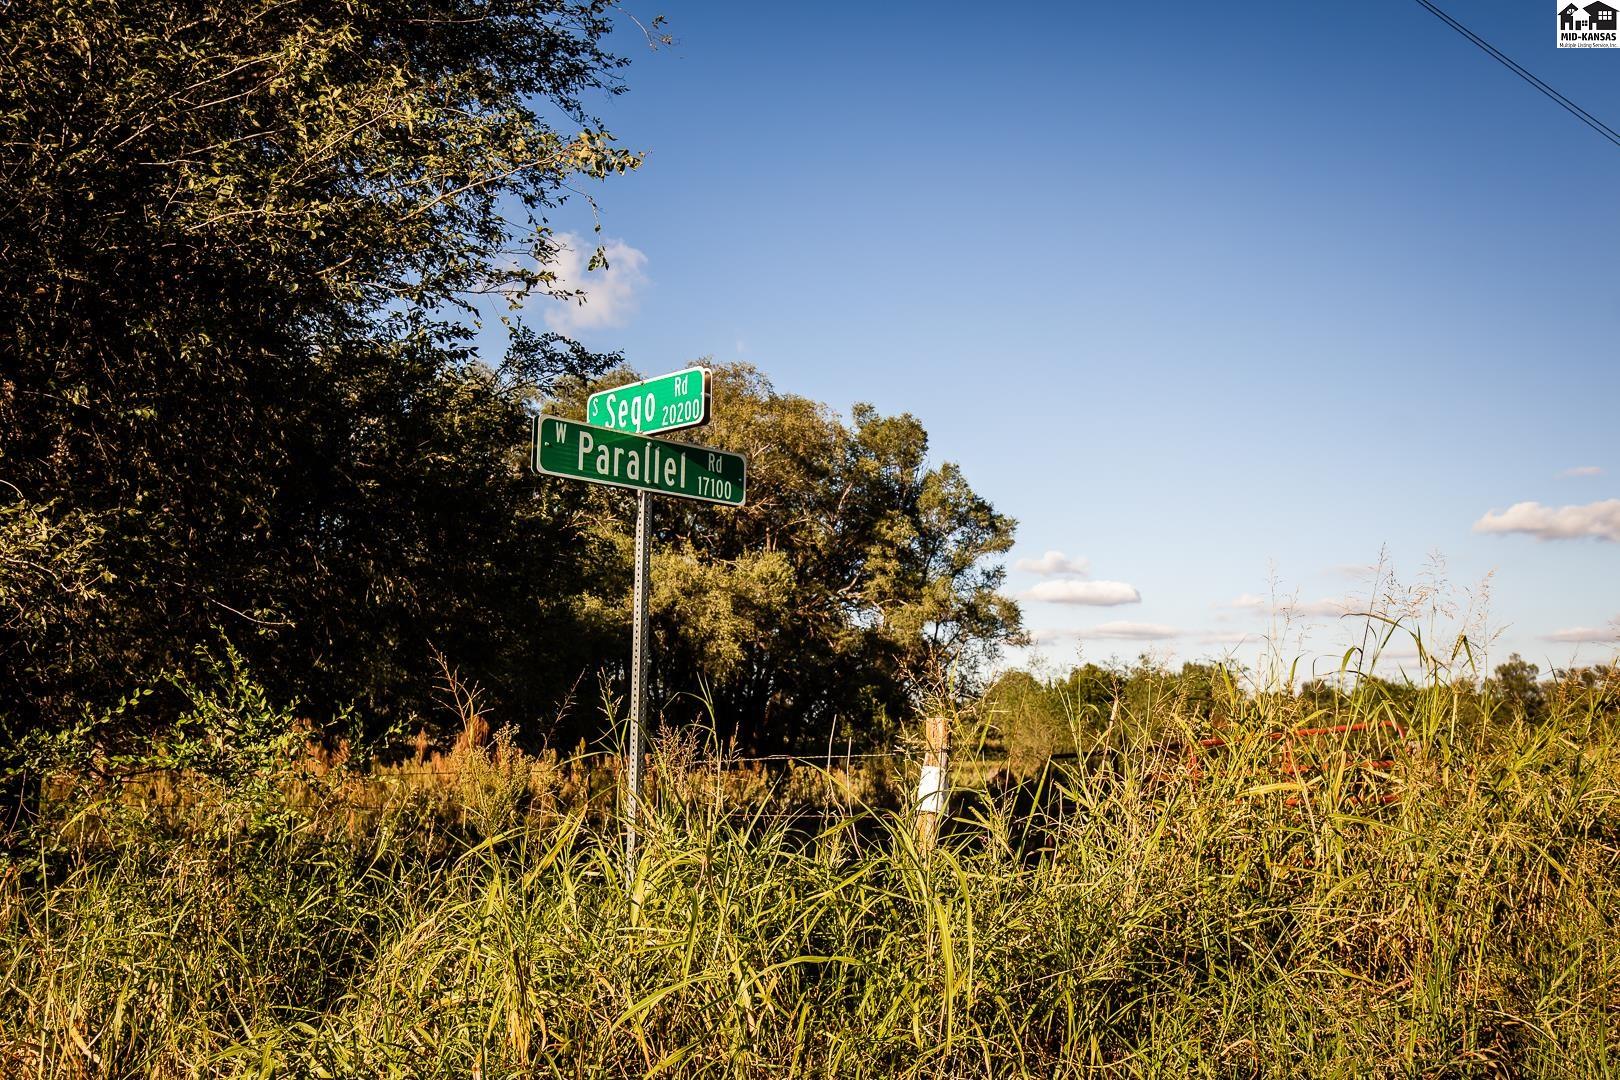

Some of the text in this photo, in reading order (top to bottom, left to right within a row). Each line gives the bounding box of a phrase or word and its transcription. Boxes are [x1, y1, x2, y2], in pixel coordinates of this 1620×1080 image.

[592, 397, 599, 417] S
[674, 376, 688, 398] Rd
[661, 398, 700, 427] 20200
[555, 421, 723, 488] W Parallel Rd
[697, 475, 732, 500] 17100
